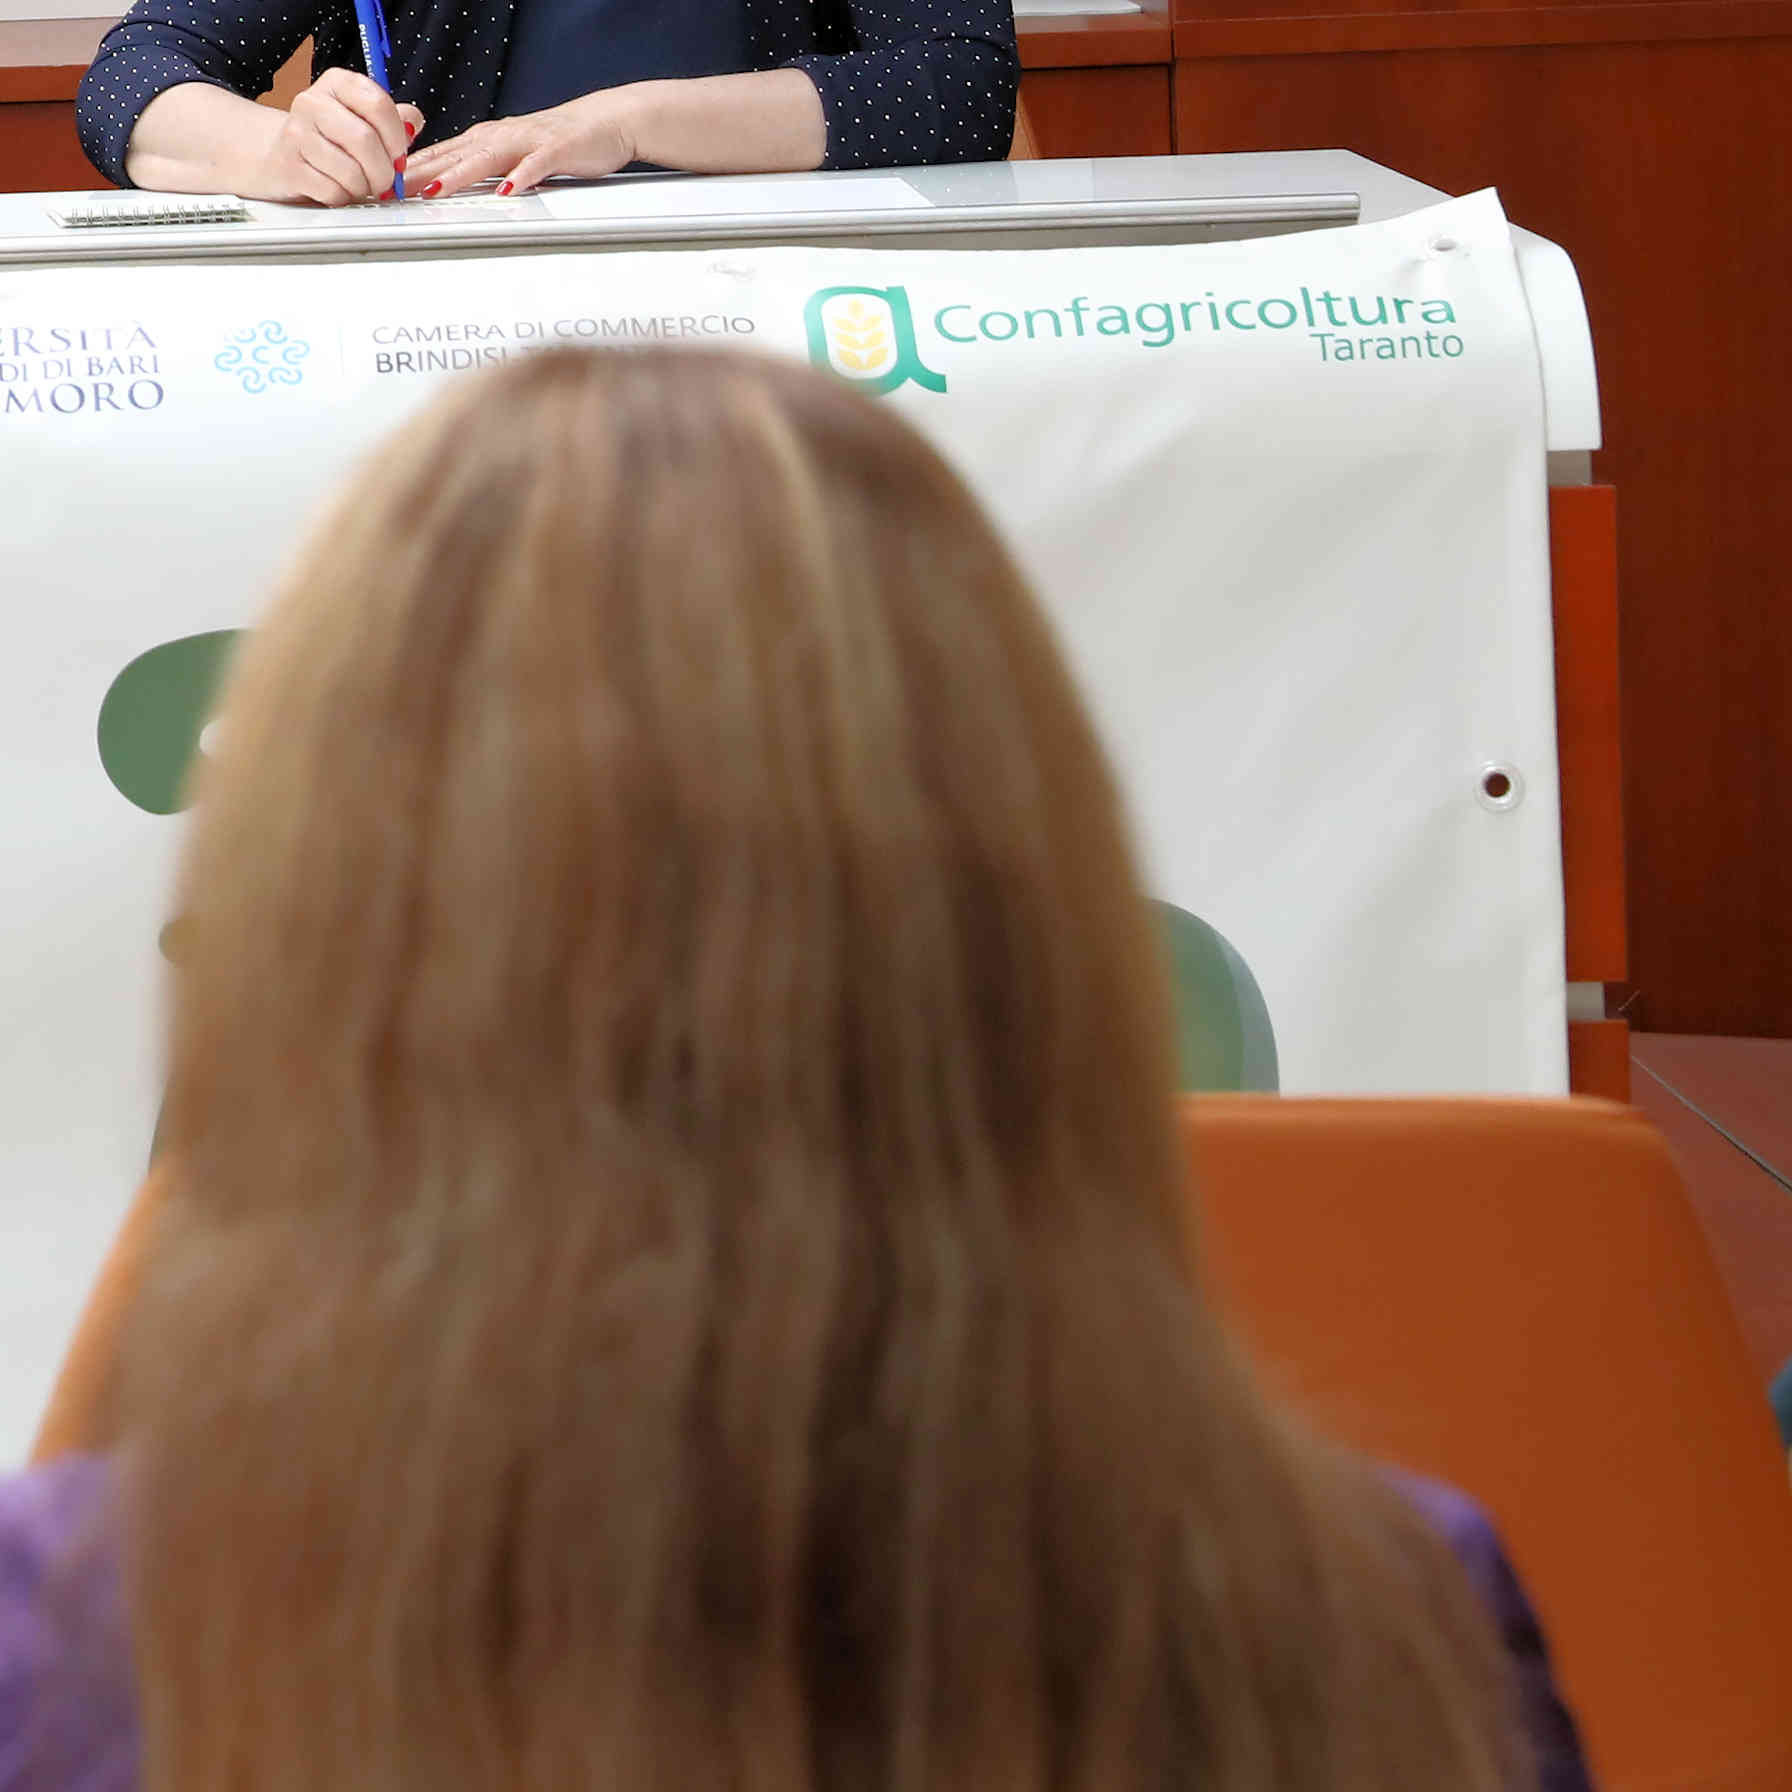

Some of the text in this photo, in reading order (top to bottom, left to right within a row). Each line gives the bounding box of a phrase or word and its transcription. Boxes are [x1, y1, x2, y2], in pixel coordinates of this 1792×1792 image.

[372, 315, 756, 345] CAMERA DI COMMERCIO
[933, 287, 1458, 348] Confagricoltura
[1309, 328, 1464, 362] Taranto
[42, 358, 73, 380] DI
[87, 354, 160, 378] BARI
[4, 379, 165, 414] MORO
